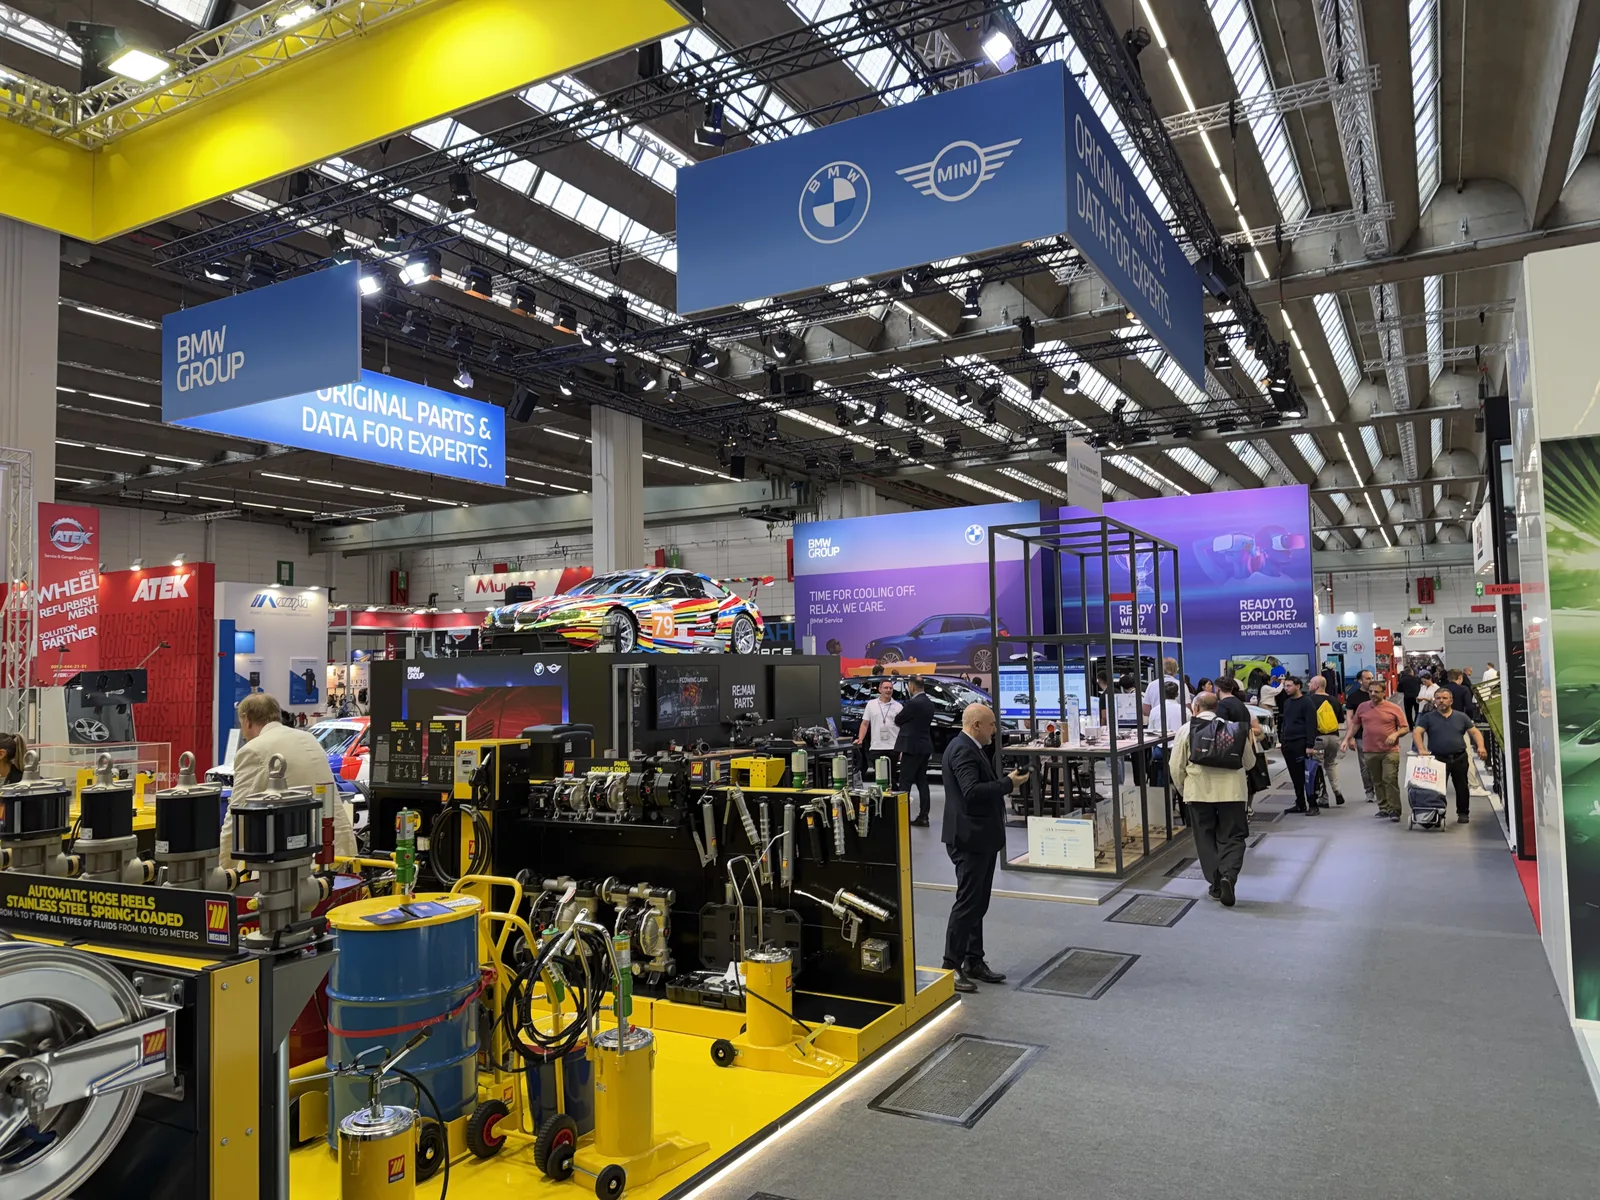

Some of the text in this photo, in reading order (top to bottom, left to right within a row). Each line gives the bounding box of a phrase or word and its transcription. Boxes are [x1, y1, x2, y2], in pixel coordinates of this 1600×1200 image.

[808, 166, 861, 194] BMW
[937, 159, 978, 183] MINI
[1074, 113, 1166, 277] ORIGINAL PARTS &
[1076, 172, 1172, 330] DATA FOR EXPERTS.
[177, 325, 227, 364] BMW
[176, 350, 245, 392] GROUP
[316, 384, 492, 440] ORIGINAL PARTS &
[301, 406, 493, 469] DATA FOR EXPERTS.
[50, 530, 94, 545] ATEK
[808, 537, 832, 549] BMW
[808, 546, 840, 559] GROUP
[78, 568, 94, 576] YOUR
[36, 573, 100, 604] WHEEL
[132, 573, 191, 603] ATEK
[475, 579, 536, 594] MULR
[809, 585, 916, 602] TIME FOR COOLING OFF.
[39, 594, 97, 619] REFURBISH
[67, 603, 99, 621] MENT
[809, 600, 886, 615] RELAX. WE CARE.
[1119, 603, 1153, 615] REDY
[1239, 597, 1294, 611] READY TO
[1120, 615, 1145, 626] WI?
[1240, 609, 1298, 622] EXPLORE?
[39, 623, 78, 641] SOLUTION
[653, 615, 673, 636] 79
[1336, 629, 1358, 638] 1992
[1448, 623, 1497, 635] Café Bar
[41, 626, 98, 651] PARTNER
[407, 666, 421, 674] BMW
[407, 672, 425, 680] GROUP
[731, 684, 756, 696] RE:MAN
[733, 697, 754, 709] PARTS
[27, 884, 156, 911] AUTOMATIC HOSE REELS
[6, 895, 184, 927] STAINLESS STEEL SPRING-LOADED
[0, 908, 13, 917] ROM
[20, 910, 29, 919] TO
[35, 912, 49, 922] FOR
[49, 914, 62, 924] ALL
[62, 916, 82, 927] TYPES
[83, 918, 93, 927] OF
[93, 919, 118, 931] FLUIDS
[118, 923, 139, 933] FROM
[139, 925, 148, 934] 10
[148, 926, 159, 935] TO
[159, 927, 169, 936] 50
[169, 928, 199, 941] METERS
